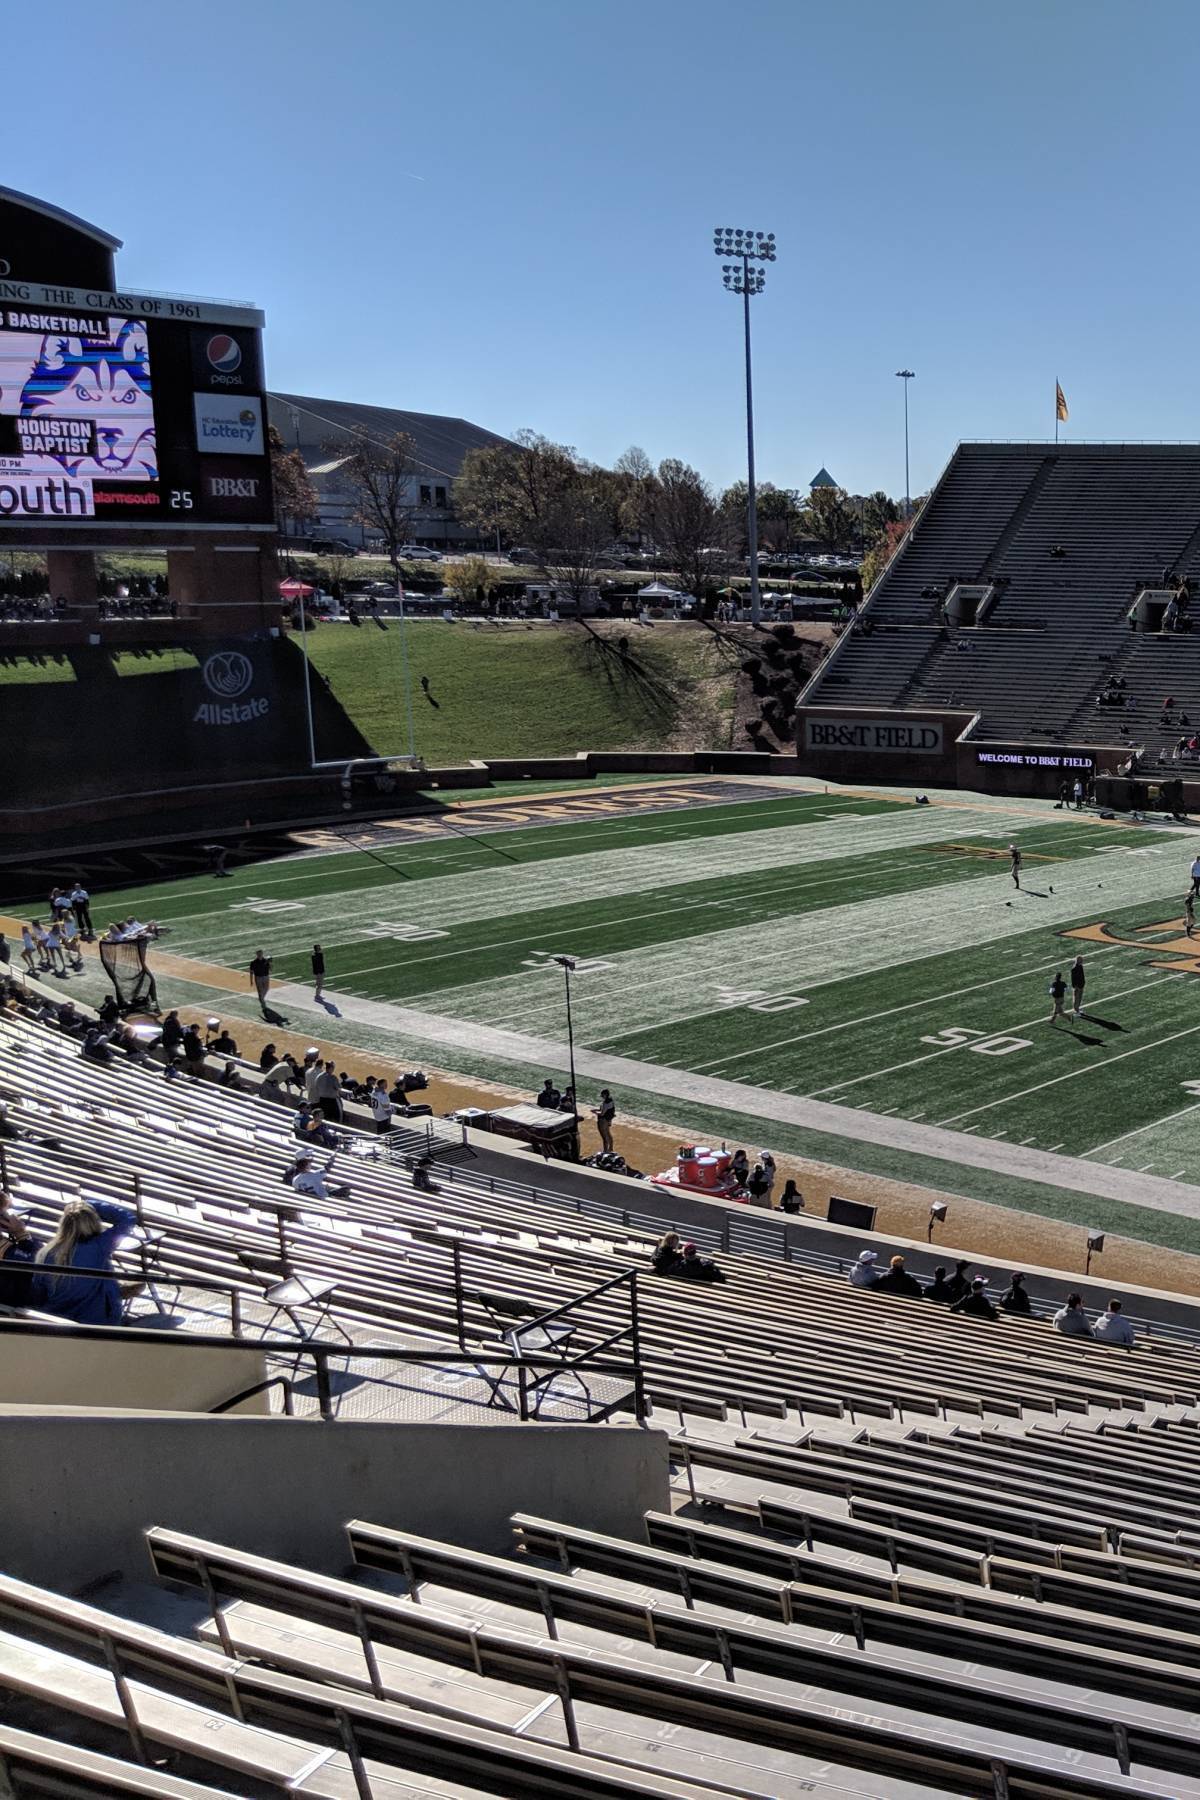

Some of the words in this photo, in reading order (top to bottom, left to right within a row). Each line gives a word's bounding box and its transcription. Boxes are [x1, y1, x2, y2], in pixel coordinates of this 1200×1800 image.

[41, 288, 76, 304] THE
[86, 293, 134, 311] CLASS
[141, 299, 162, 312] OF
[168, 303, 201, 318] 1961
[8, 312, 106, 335] BASKETBALL
[210, 374, 243, 385] pepsi
[17, 418, 92, 437] HOUSTON
[203, 424, 255, 442] Lottery
[21, 436, 89, 453] BAPTIST
[211, 477, 259, 497] BB&T
[171, 491, 193, 508] 25
[194, 697, 269, 726] Allstate
[810, 724, 870, 745] BB&T
[875, 727, 939, 749] FIELD
[979, 753, 1023, 764] WELCOME
[1025, 756, 1038, 765] TO
[1039, 757, 1061, 766] BB&T
[1063, 758, 1092, 768] FIELD
[374, 789, 722, 834] FOREST
[920, 1027, 1034, 1056] 50
